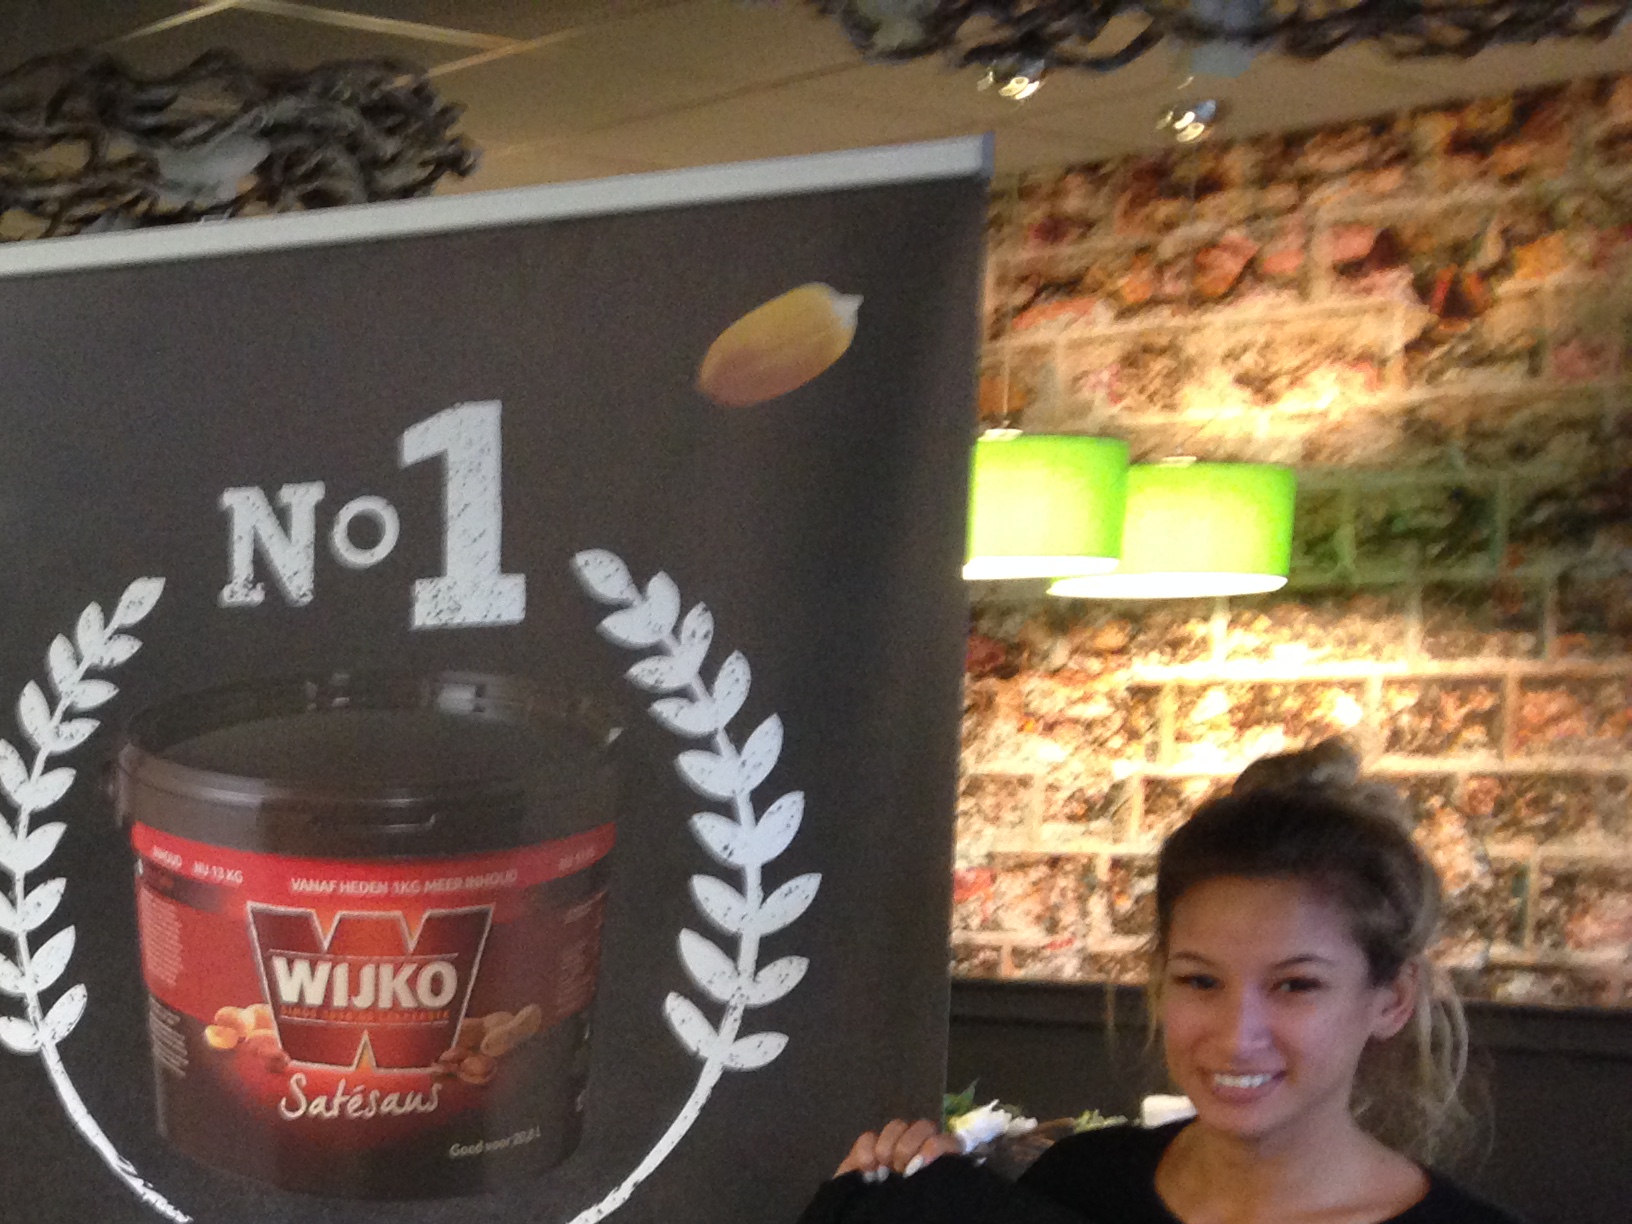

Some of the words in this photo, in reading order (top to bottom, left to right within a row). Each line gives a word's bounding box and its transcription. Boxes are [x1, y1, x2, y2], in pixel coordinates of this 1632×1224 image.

[290, 877, 338, 893] VANAF
[339, 880, 389, 895] HEDEN
[392, 880, 420, 894] 1KG
[424, 876, 464, 893] MEER
[465, 869, 518, 889] INHOUD
[271, 956, 459, 1010] WIJKO
[280, 1072, 443, 1121] Satésaus
